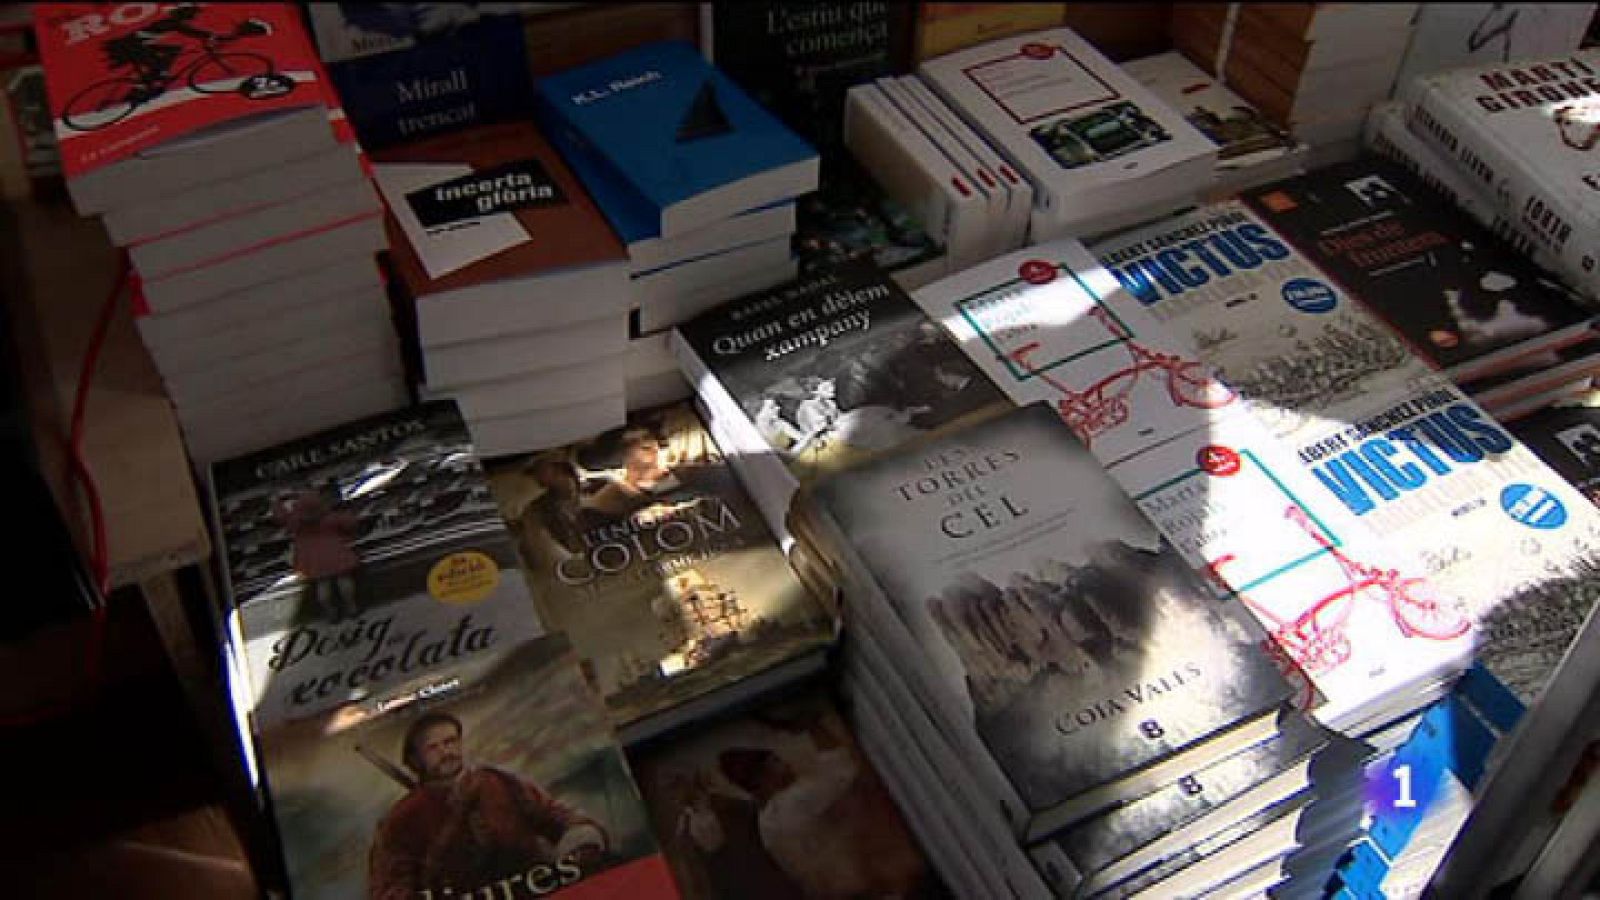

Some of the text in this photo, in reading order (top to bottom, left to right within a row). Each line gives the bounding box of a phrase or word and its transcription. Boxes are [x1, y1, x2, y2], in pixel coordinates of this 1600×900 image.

[395, 68, 468, 102] Mirall
[397, 100, 477, 139] trencat
[434, 170, 532, 202] Incerta
[1100, 222, 1290, 308] VICTUS
[712, 319, 783, 355] Quan
[788, 308, 819, 330] en
[764, 308, 870, 362] xampany
[889, 451, 1019, 501] TORRES
[1310, 403, 1513, 517] VICTUS
[556, 498, 742, 585] COLOM
[940, 496, 1030, 539] CEL
[267, 615, 392, 673] Desig
[293, 613, 496, 705] xocolata
[1055, 661, 1202, 735] COIA VALLS
